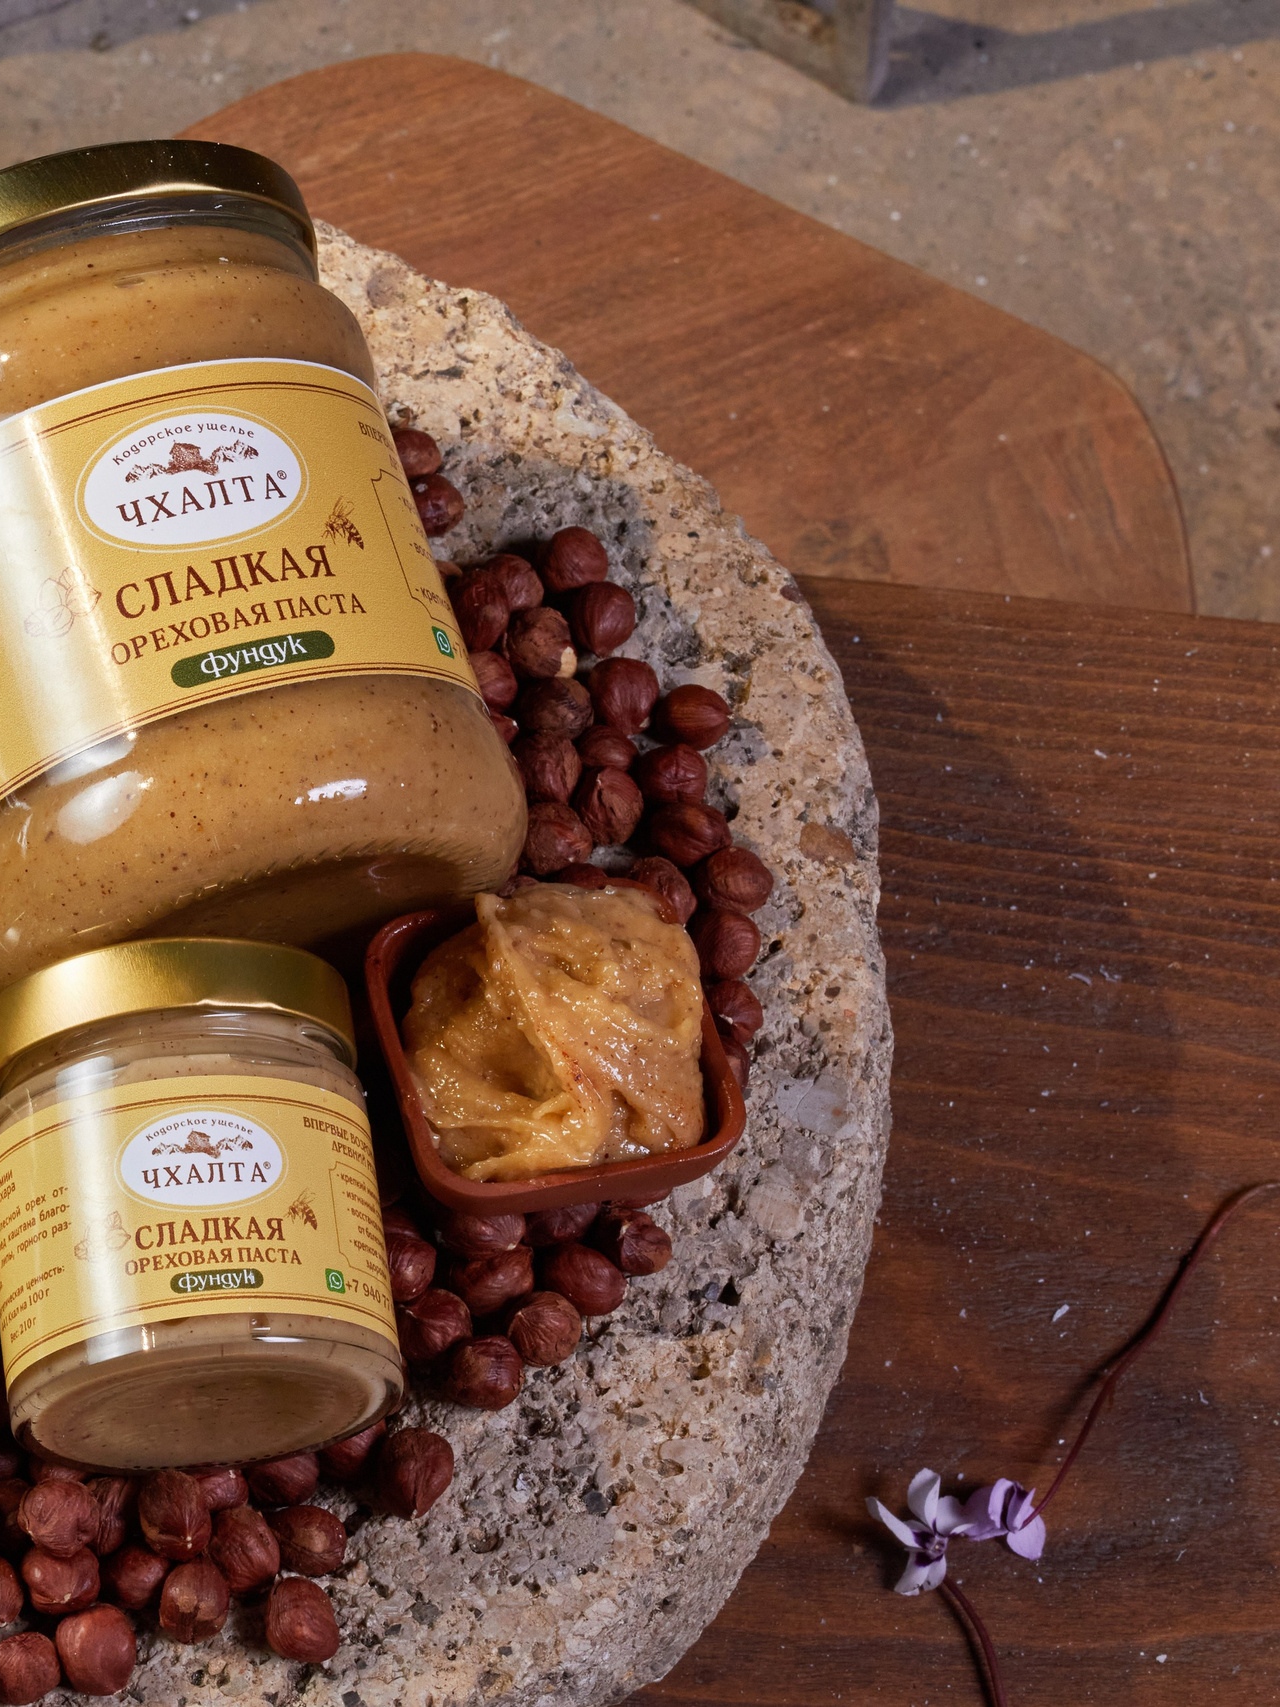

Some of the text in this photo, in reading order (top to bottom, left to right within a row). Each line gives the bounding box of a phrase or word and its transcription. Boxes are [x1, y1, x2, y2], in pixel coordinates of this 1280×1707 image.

[112, 423, 192, 466] Кодорское
[115, 545, 336, 619] СЛАДКАЯ
[111, 593, 367, 665] ОРЕХОВАЯ ПАСТА
[200, 635, 307, 678] фундук
[145, 1118, 207, 1142] Кодорское
[303, 1116, 349, 1141] ВПЕРВЫЕ
[25, 1194, 46, 1212] орех
[52, 1186, 69, 1198] от-
[8, 1217, 36, 1242] каштана
[39, 1203, 70, 1222] благо-
[51, 1221, 72, 1237] раз-
[135, 1216, 285, 1250] СЛАДКАЯ
[124, 1247, 302, 1276] ОРЕХОВАЯ ПАСТА
[26, 1265, 65, 1290] ценность:
[178, 1268, 256, 1293] фундук
[28, 1289, 44, 1306] 100
[346, 1279, 359, 1293] +7
[362, 1283, 380, 1303] 940
[20, 1318, 32, 1335] 210
